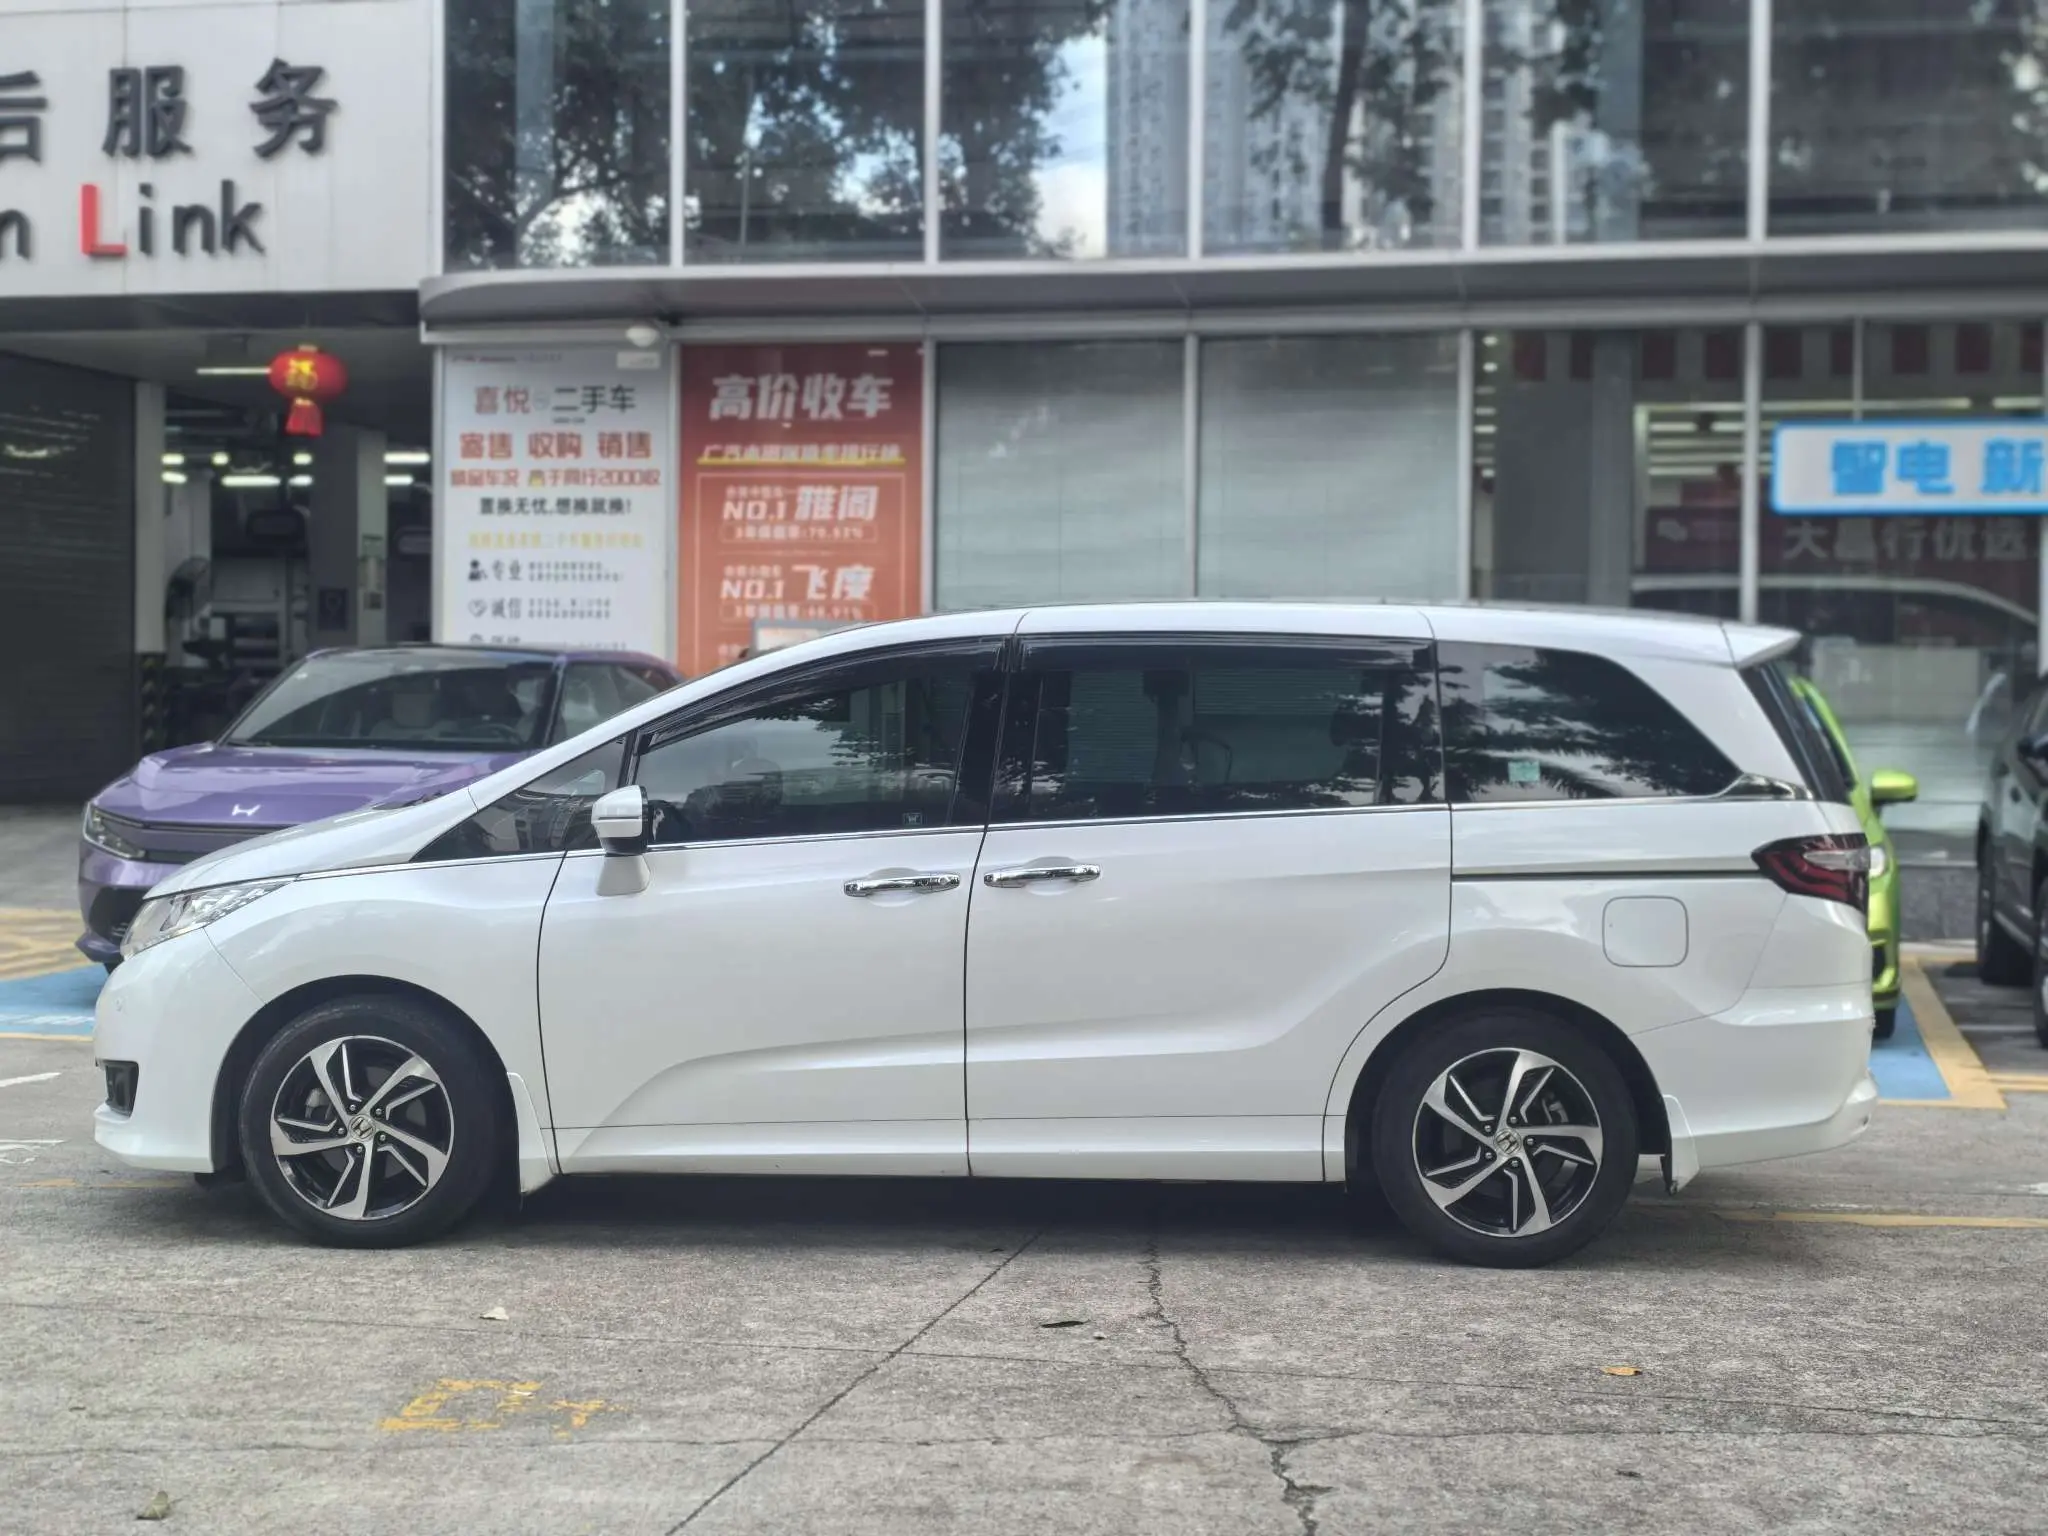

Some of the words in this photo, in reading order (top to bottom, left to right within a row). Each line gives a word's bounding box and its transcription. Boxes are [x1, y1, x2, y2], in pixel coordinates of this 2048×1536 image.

[81, 179, 265, 258] Link
[475, 387, 530, 414] 喜悦
[553, 384, 635, 414] 二手车
[709, 374, 893, 421] 高价收车
[528, 432, 582, 459] 收购
[597, 431, 652, 459] 销售
[723, 502, 787, 521] NO.1
[794, 486, 879, 521] 雅阁
[720, 580, 785, 600] NO.1
[792, 564, 875, 600] 飞度
